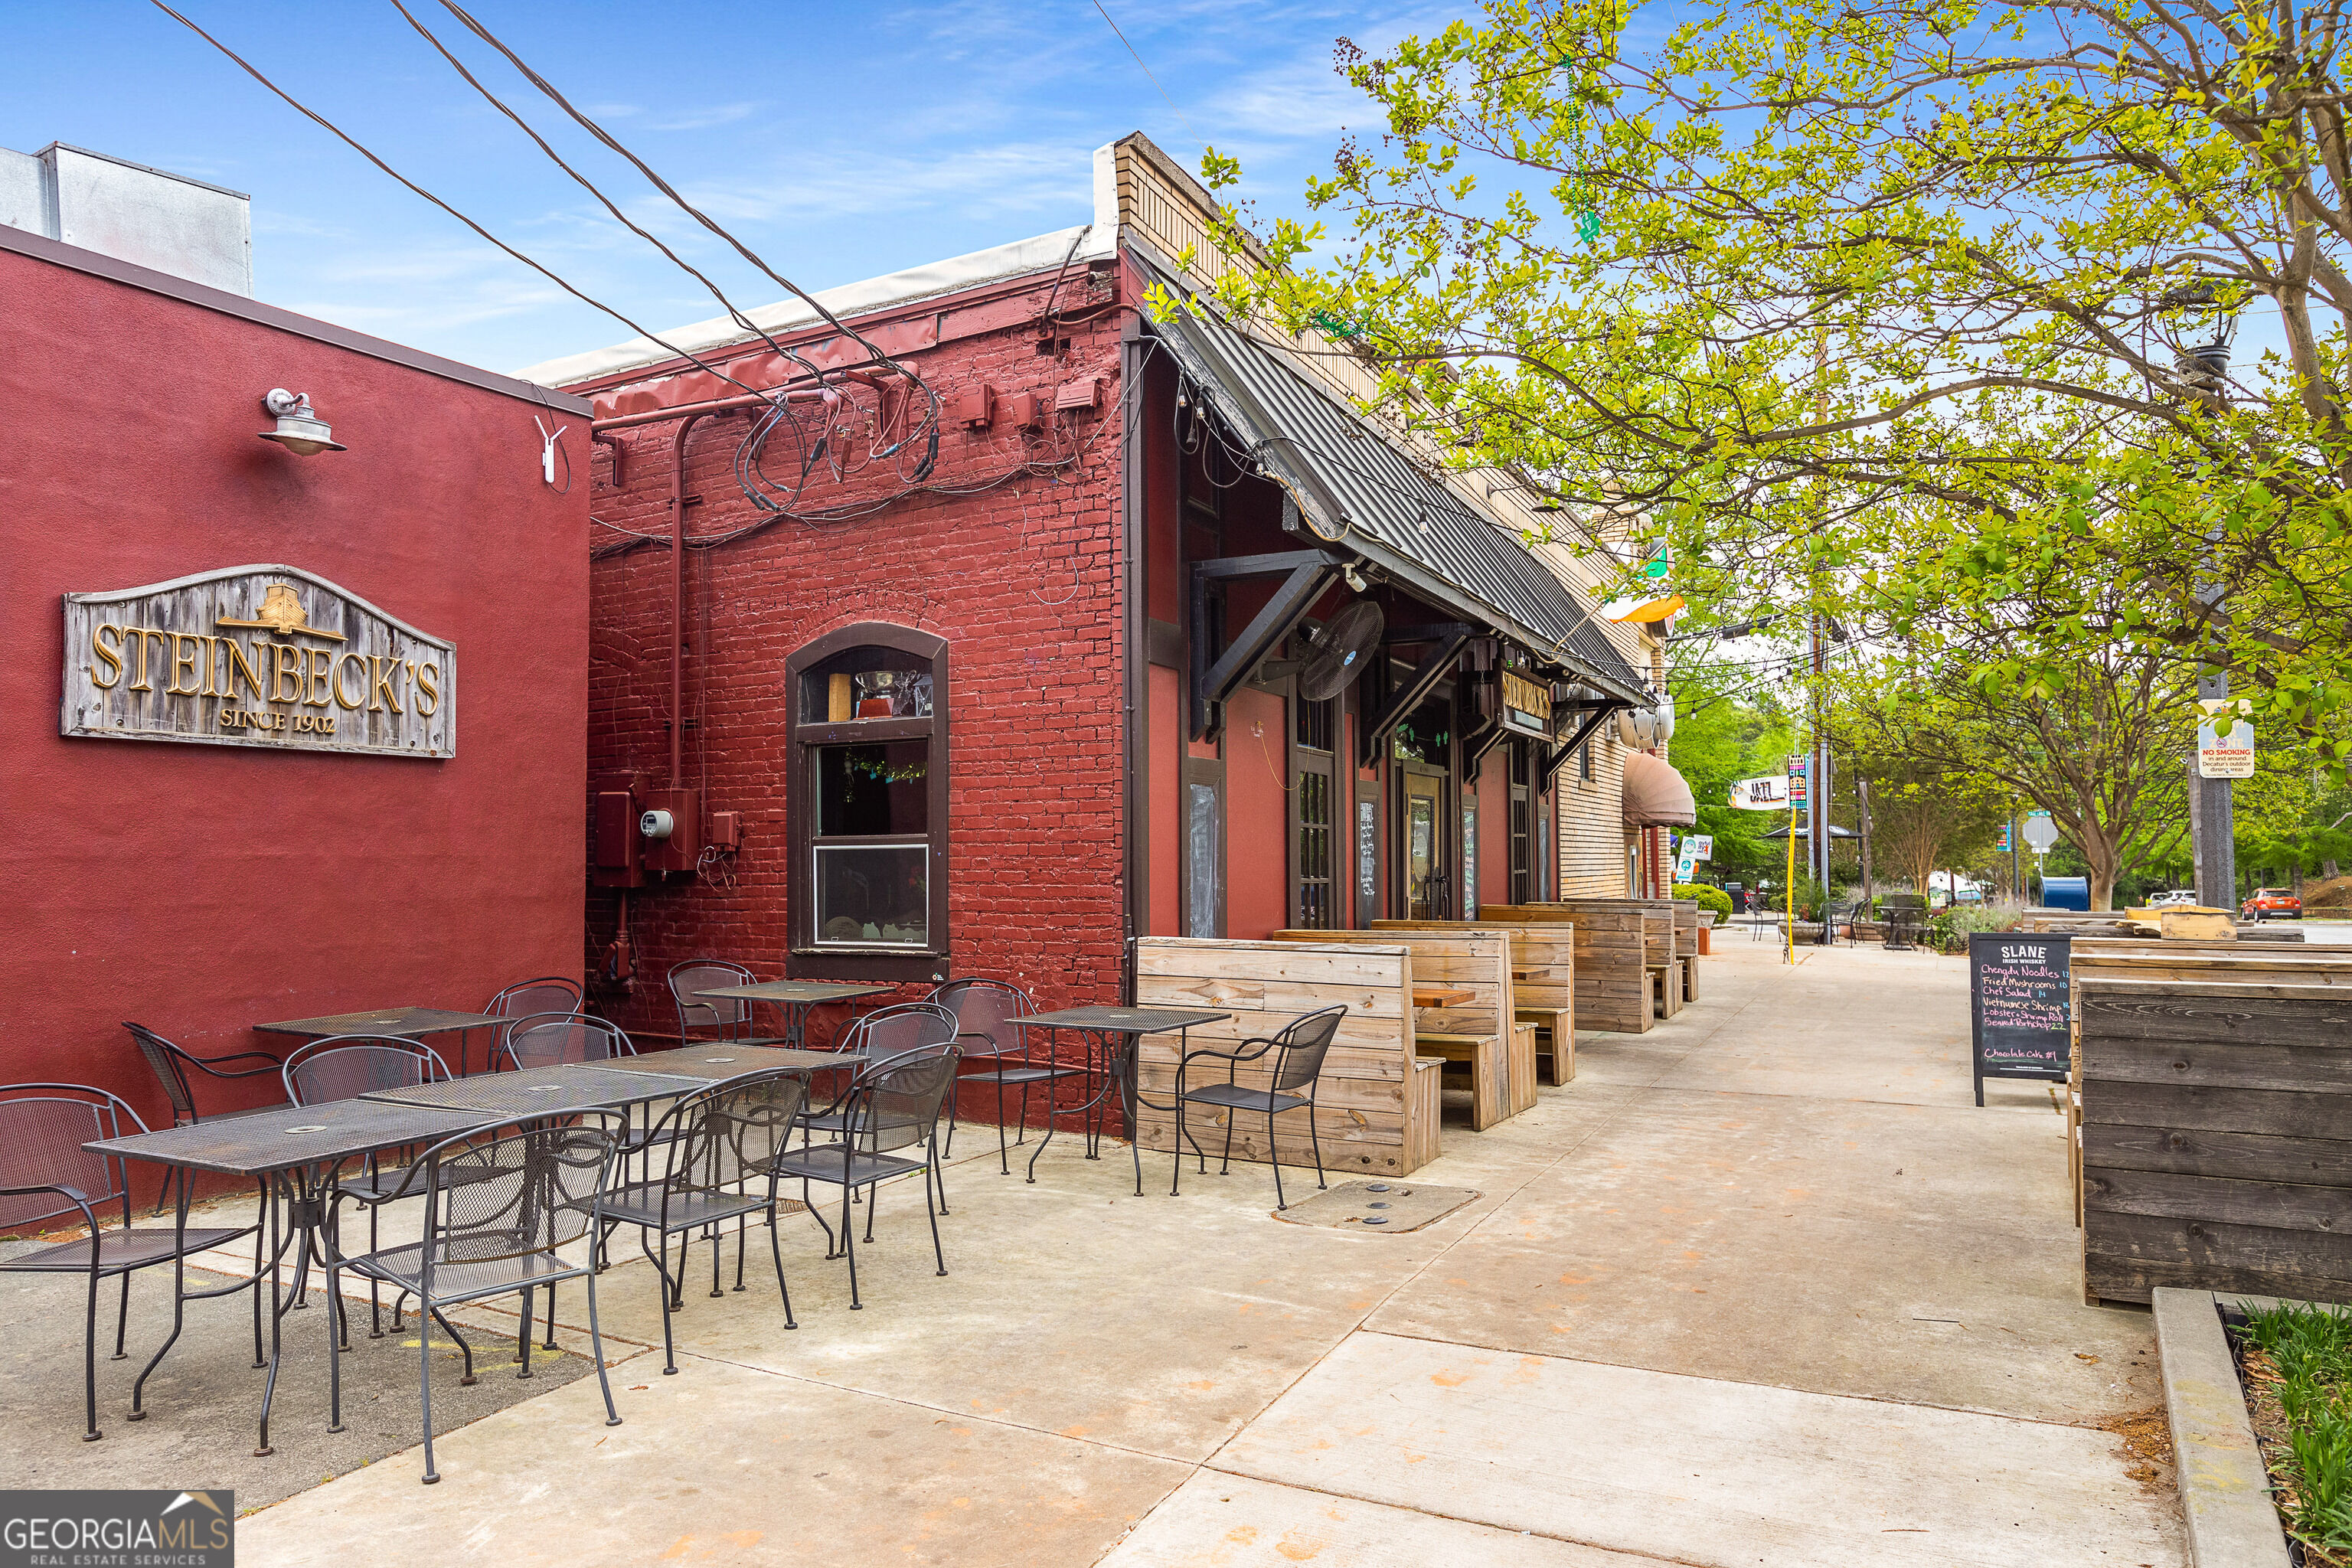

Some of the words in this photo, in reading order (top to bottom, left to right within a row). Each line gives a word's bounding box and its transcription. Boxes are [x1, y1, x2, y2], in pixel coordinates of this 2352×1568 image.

[90, 623, 439, 716] STEINBECK'S
[220, 708, 286, 730] SINCE
[293, 714, 336, 734] 1902
[2001, 946, 2047, 959] SLANE
[1981, 964, 2019, 980] Chengdu
[2022, 965, 2060, 979] Noodles
[1982, 977, 2007, 986] Fried
[2009, 978, 2056, 989] Mushrooms
[1983, 986, 2003, 995] Chef
[2006, 987, 2032, 998] Salad
[2031, 1000, 2062, 1015] Shrimp
[1983, 1008, 2015, 1017] Lobster
[2021, 1011, 2048, 1022] Shrimp
[2049, 1012, 2063, 1022] Roll
